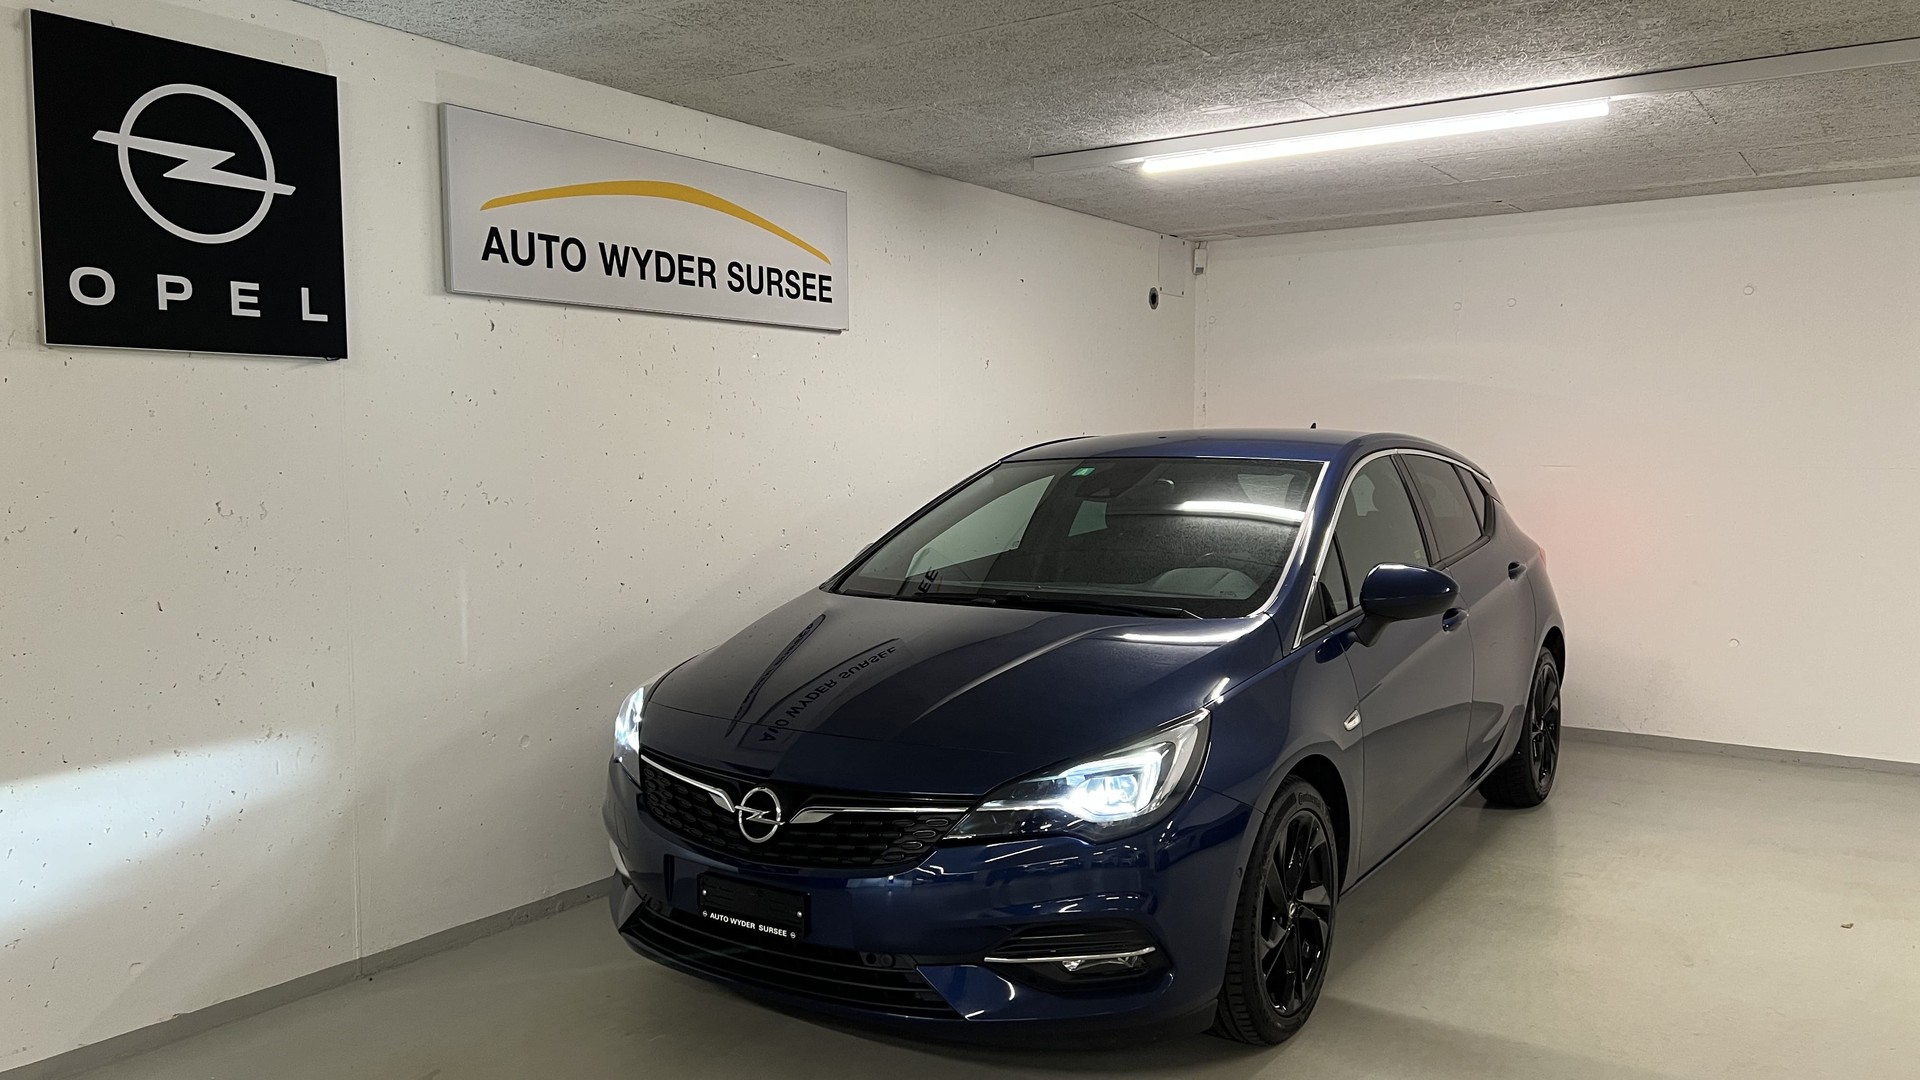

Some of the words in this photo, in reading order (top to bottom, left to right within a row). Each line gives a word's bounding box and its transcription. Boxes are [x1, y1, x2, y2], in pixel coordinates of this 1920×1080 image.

[481, 226, 588, 273] AUTO
[598, 241, 717, 290] WYDER
[727, 261, 833, 304] SURSEE
[69, 266, 329, 323] OPEL
[710, 912, 729, 922] AUTO
[730, 918, 756, 929] WYDER
[758, 924, 787, 937] SURSEE
